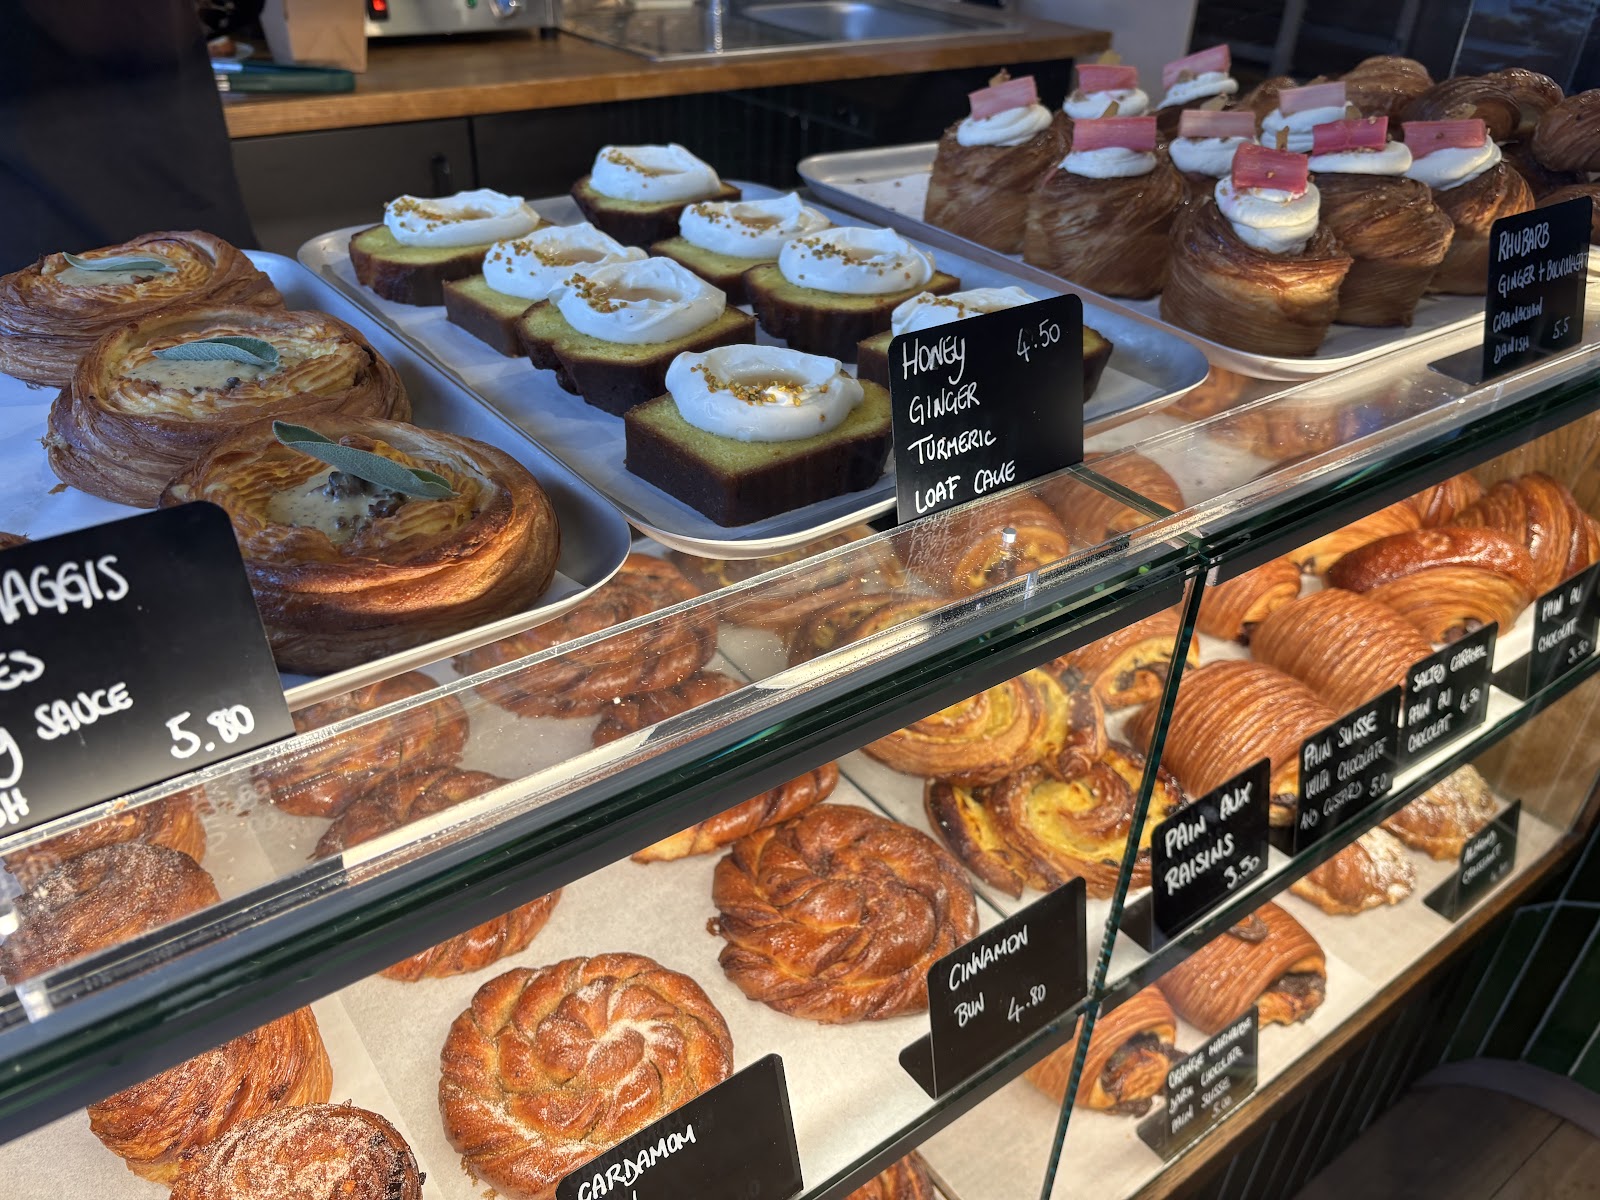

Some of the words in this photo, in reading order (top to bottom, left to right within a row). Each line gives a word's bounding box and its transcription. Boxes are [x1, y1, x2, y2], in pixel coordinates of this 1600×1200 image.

[1498, 222, 1550, 262] RHUBARB
[1498, 265, 1536, 298] GINGER
[1016, 318, 1061, 363] 4.50
[1493, 335, 1530, 365] DANISH
[909, 381, 981, 426] GINGER
[907, 429, 998, 466] TURMERIC
[915, 475, 962, 514] LOAF
[1570, 584, 1582, 605] AU
[34, 682, 134, 741] SAUCE
[165, 703, 256, 760] 5.80
[1408, 697, 1432, 727] PAIN
[1437, 687, 1453, 711] AU
[1304, 736, 1333, 772] PAIN
[1338, 709, 1379, 749] SUISSE
[1165, 815, 1207, 860] PAIN
[1219, 781, 1253, 822] AUX
[1164, 833, 1236, 897] RAISINS
[948, 924, 1029, 992] CINNAMON
[954, 991, 985, 1028] BUN
[1007, 984, 1047, 1024] 4.80
[1168, 1051, 1206, 1090] ORANGE
[1171, 1104, 1194, 1135] PAIN
